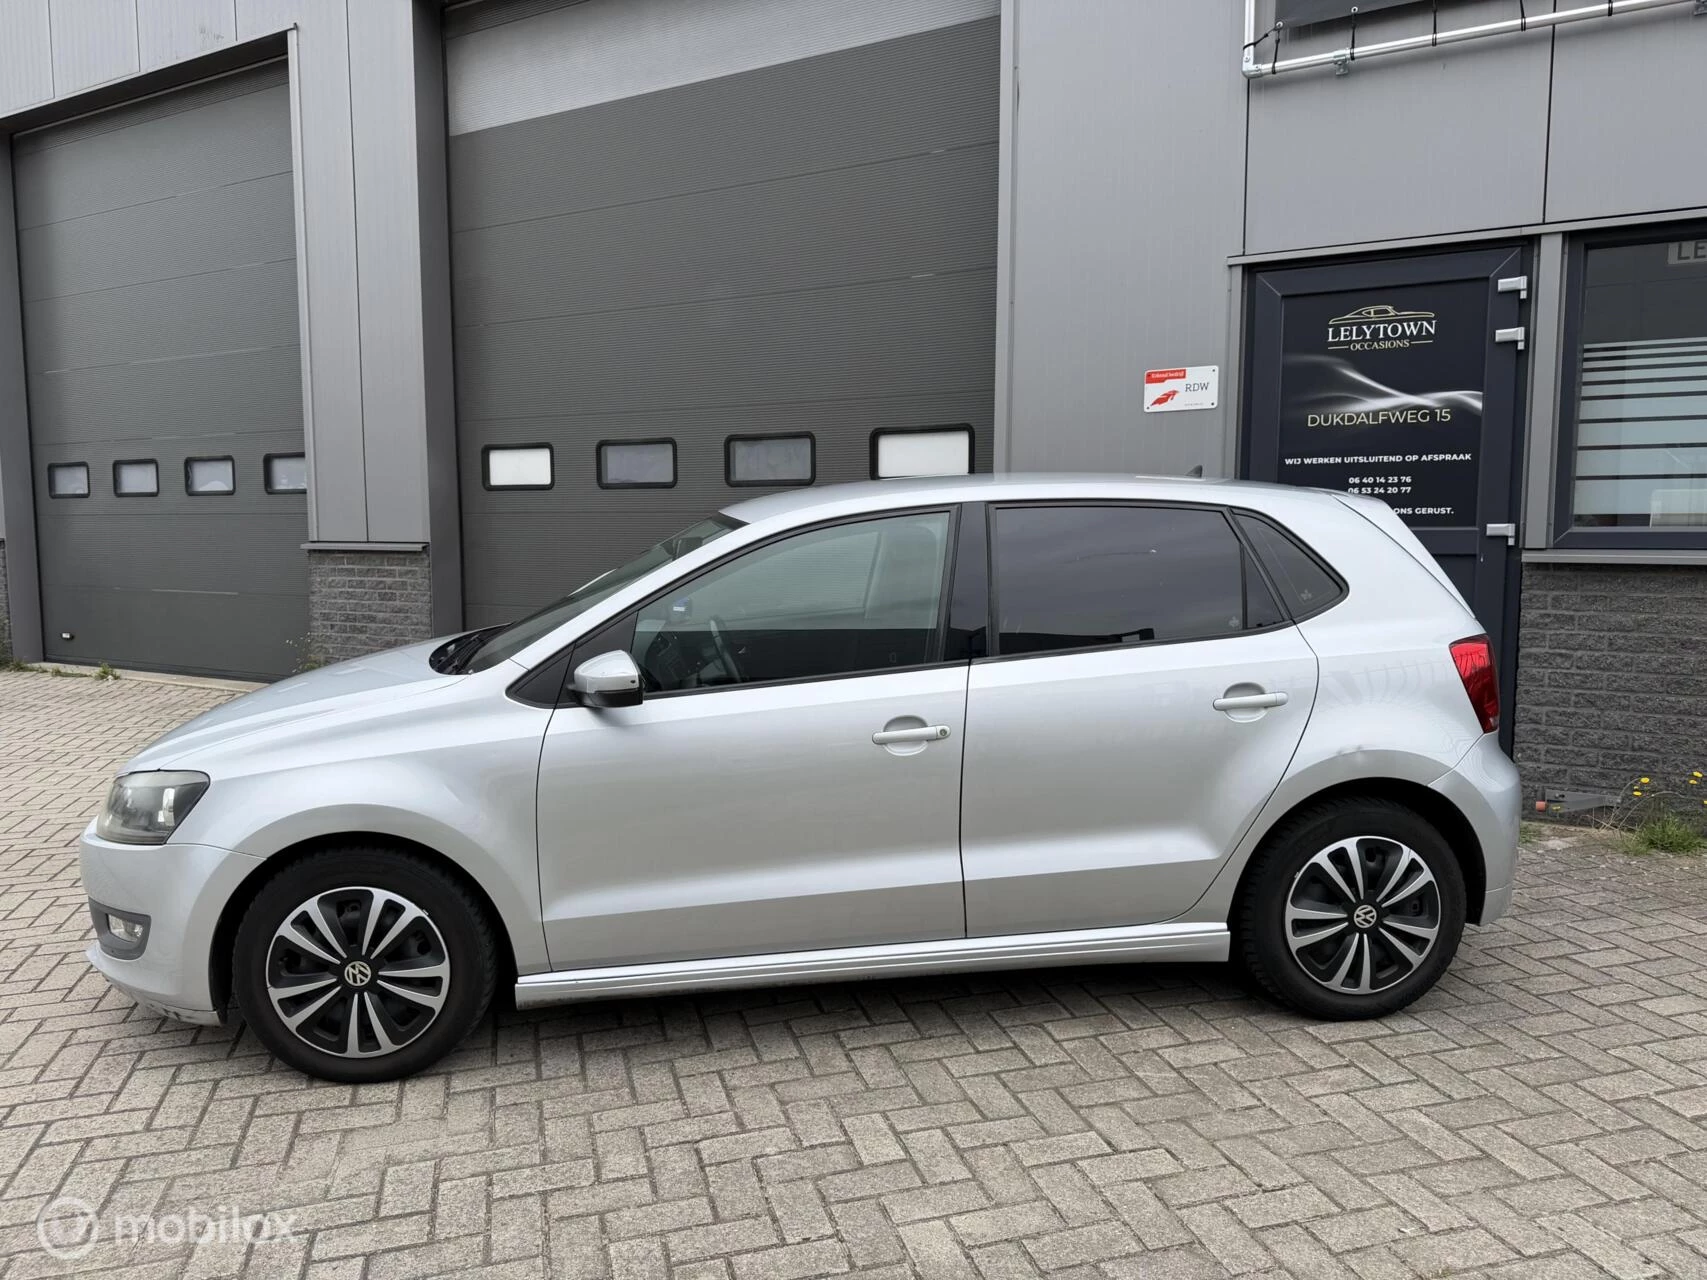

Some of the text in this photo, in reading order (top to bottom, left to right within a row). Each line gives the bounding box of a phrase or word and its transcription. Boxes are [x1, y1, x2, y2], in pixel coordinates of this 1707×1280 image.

[1327, 319, 1437, 343] LELYTOWN
[1350, 339, 1410, 351] OCCASIONS
[1185, 382, 1210, 392] RDW
[1307, 408, 1451, 427] DUKDALFWEG 15
[1303, 456, 1342, 464] WERKEN
[1344, 455, 1403, 463] UITSLUITEND
[1405, 454, 1419, 462] OP
[1421, 453, 1472, 462] AFSPRAAK
[1362, 476, 1374, 484] 40
[1387, 486, 1398, 494] 20
[1415, 507, 1454, 515] GERUST.
